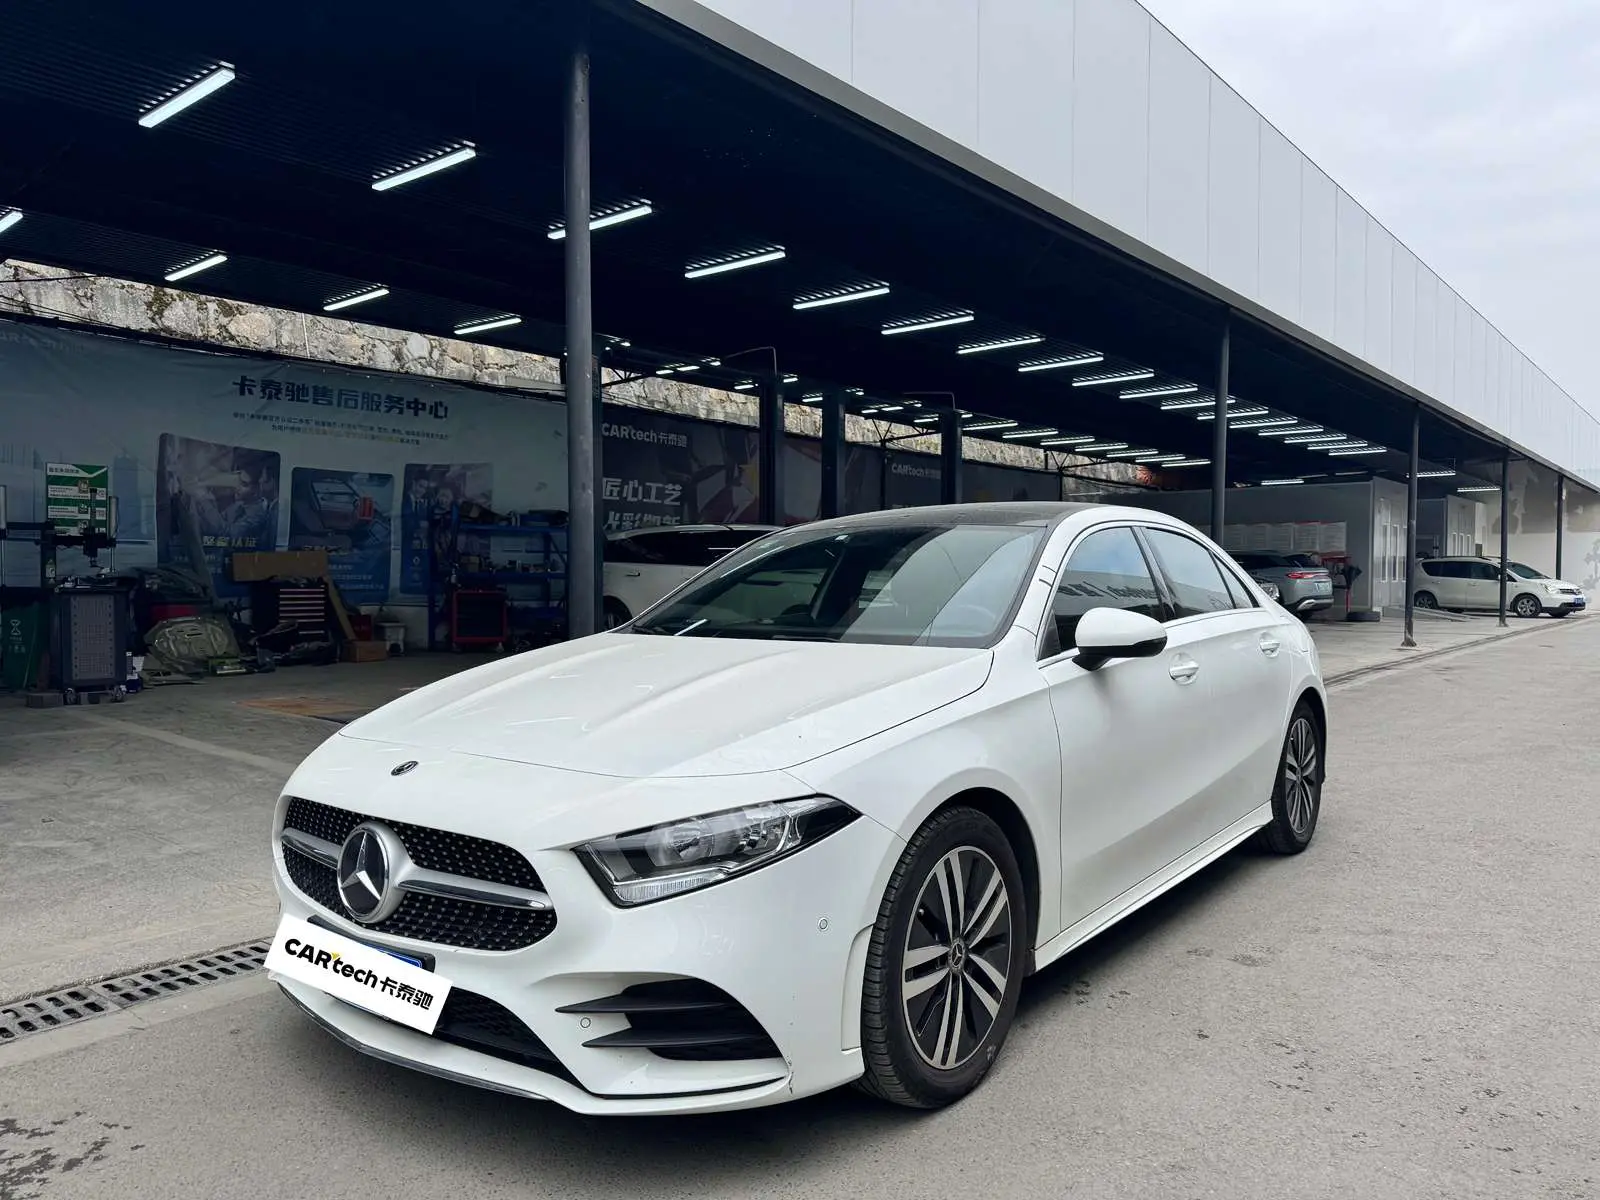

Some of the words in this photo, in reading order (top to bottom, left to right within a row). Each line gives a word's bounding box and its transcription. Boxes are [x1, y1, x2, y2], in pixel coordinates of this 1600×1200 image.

[232, 375, 448, 420] 卡泰驰售后服务中心
[601, 422, 657, 443] CARtech
[602, 477, 683, 506] 匠心工艺
